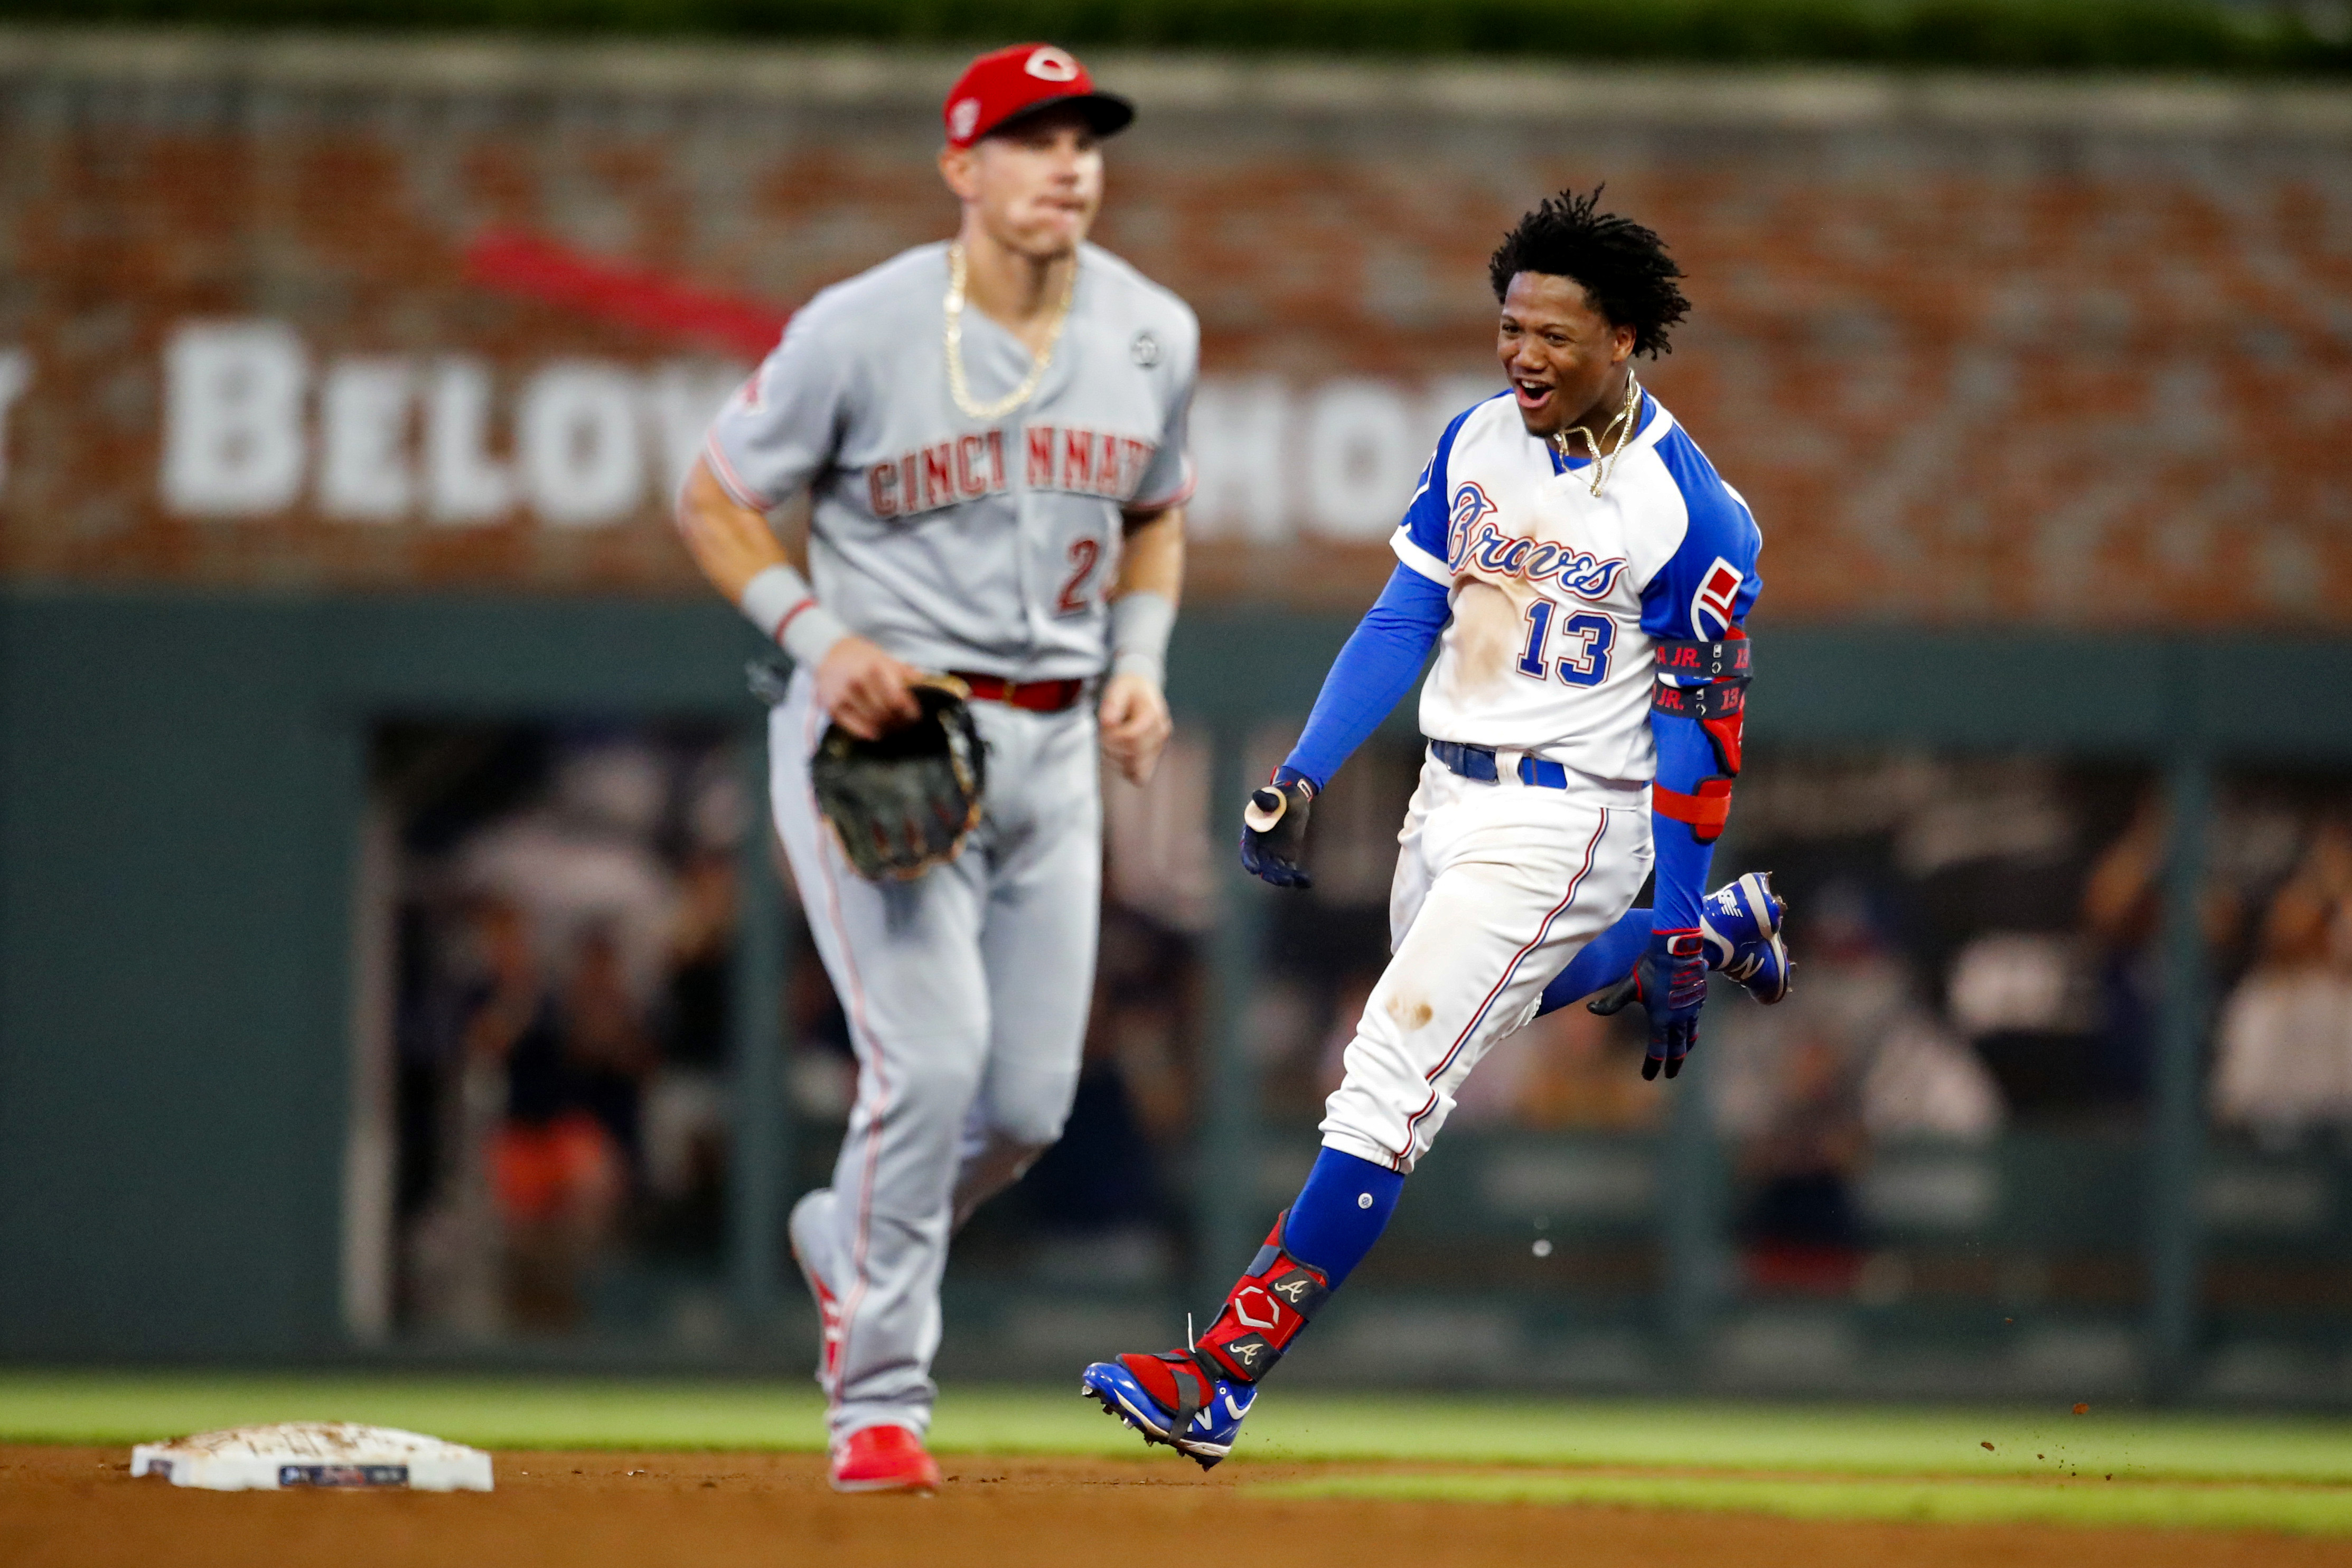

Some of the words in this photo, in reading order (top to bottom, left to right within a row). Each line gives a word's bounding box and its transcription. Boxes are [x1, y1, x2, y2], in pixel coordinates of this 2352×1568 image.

[1446, 480, 1629, 601] Braves
[1516, 598, 1617, 690] 13
[1671, 647, 1701, 668] JR.
[1656, 688, 1685, 710] JR.
[1720, 687, 1740, 711] 13
